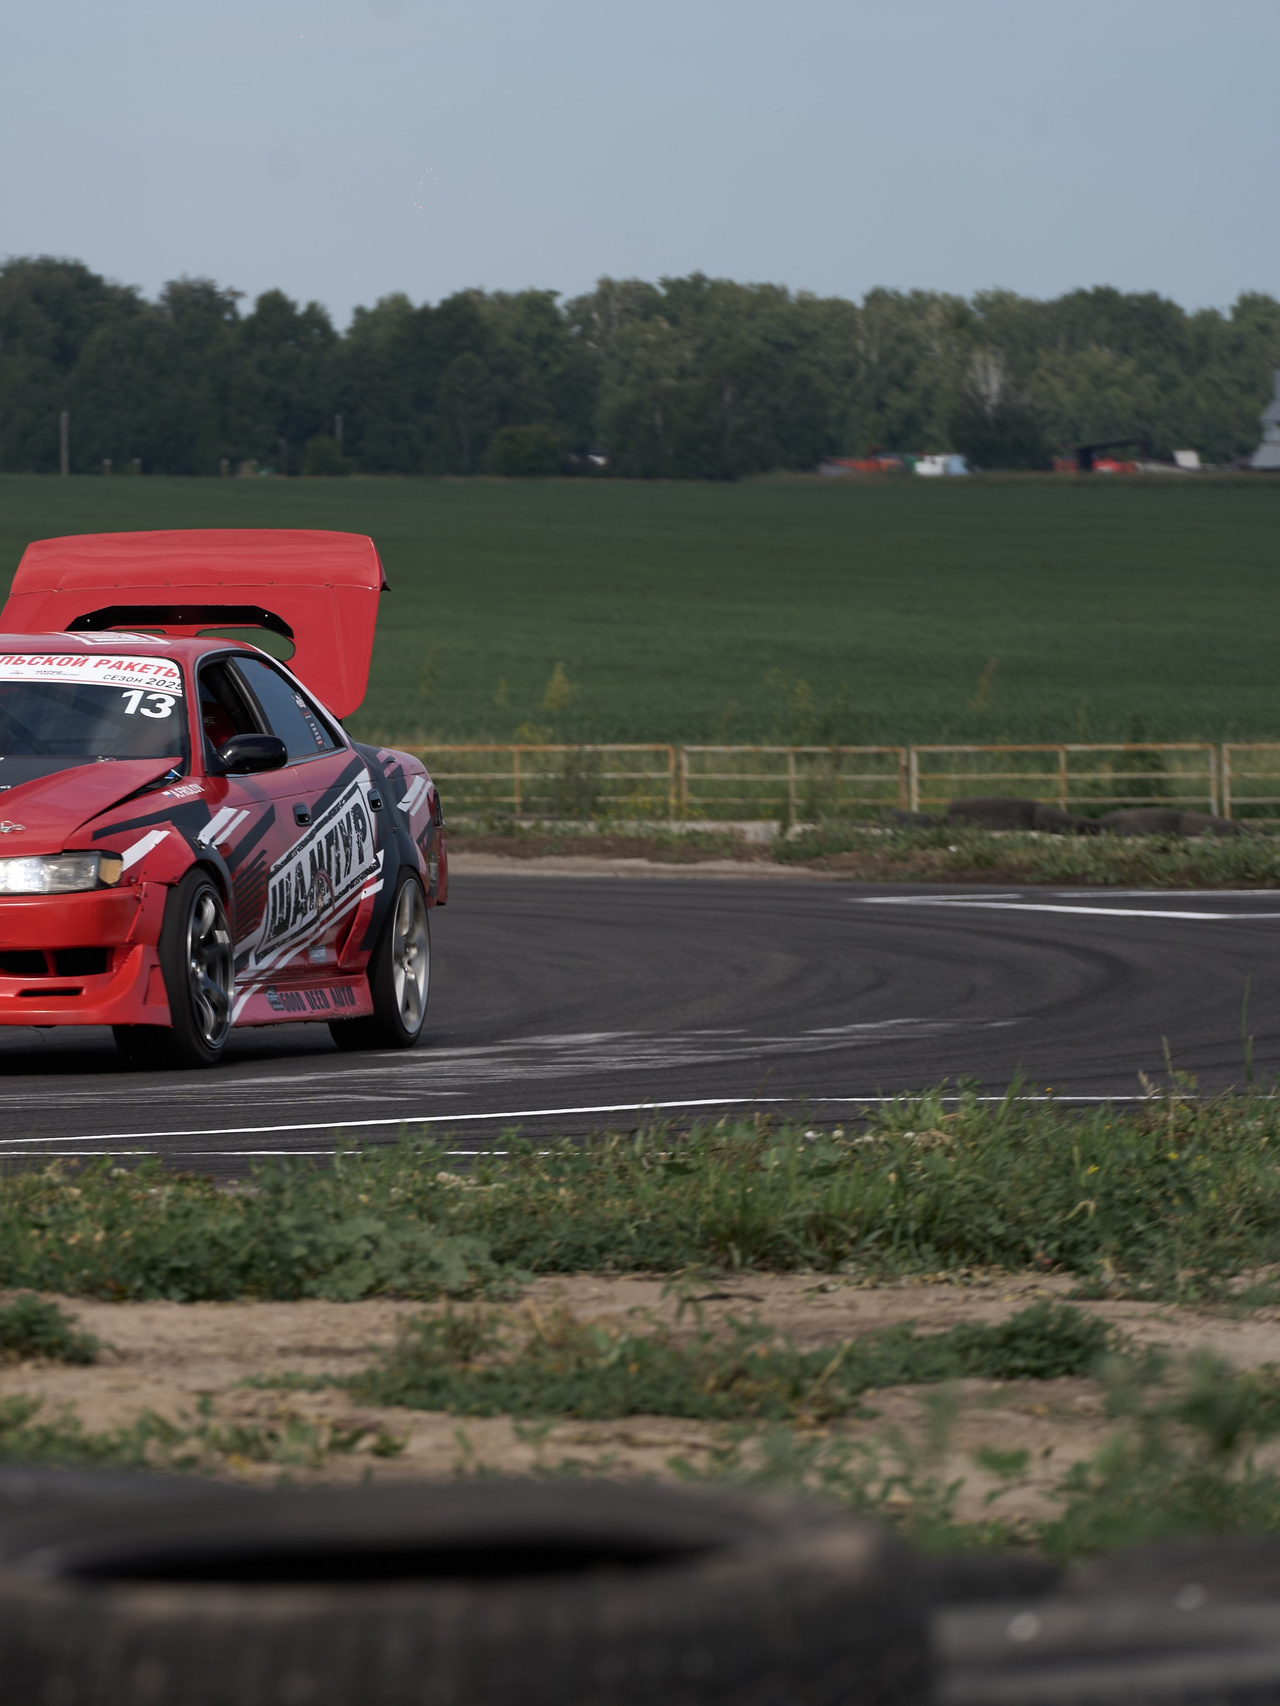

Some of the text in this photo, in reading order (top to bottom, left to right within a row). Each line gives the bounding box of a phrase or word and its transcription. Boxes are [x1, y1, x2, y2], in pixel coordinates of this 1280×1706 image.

[102, 674, 143, 683] СЕЗОН
[122, 689, 176, 719] 13
[269, 801, 369, 940] ШАМПУР
[329, 985, 356, 1008] AUTO
